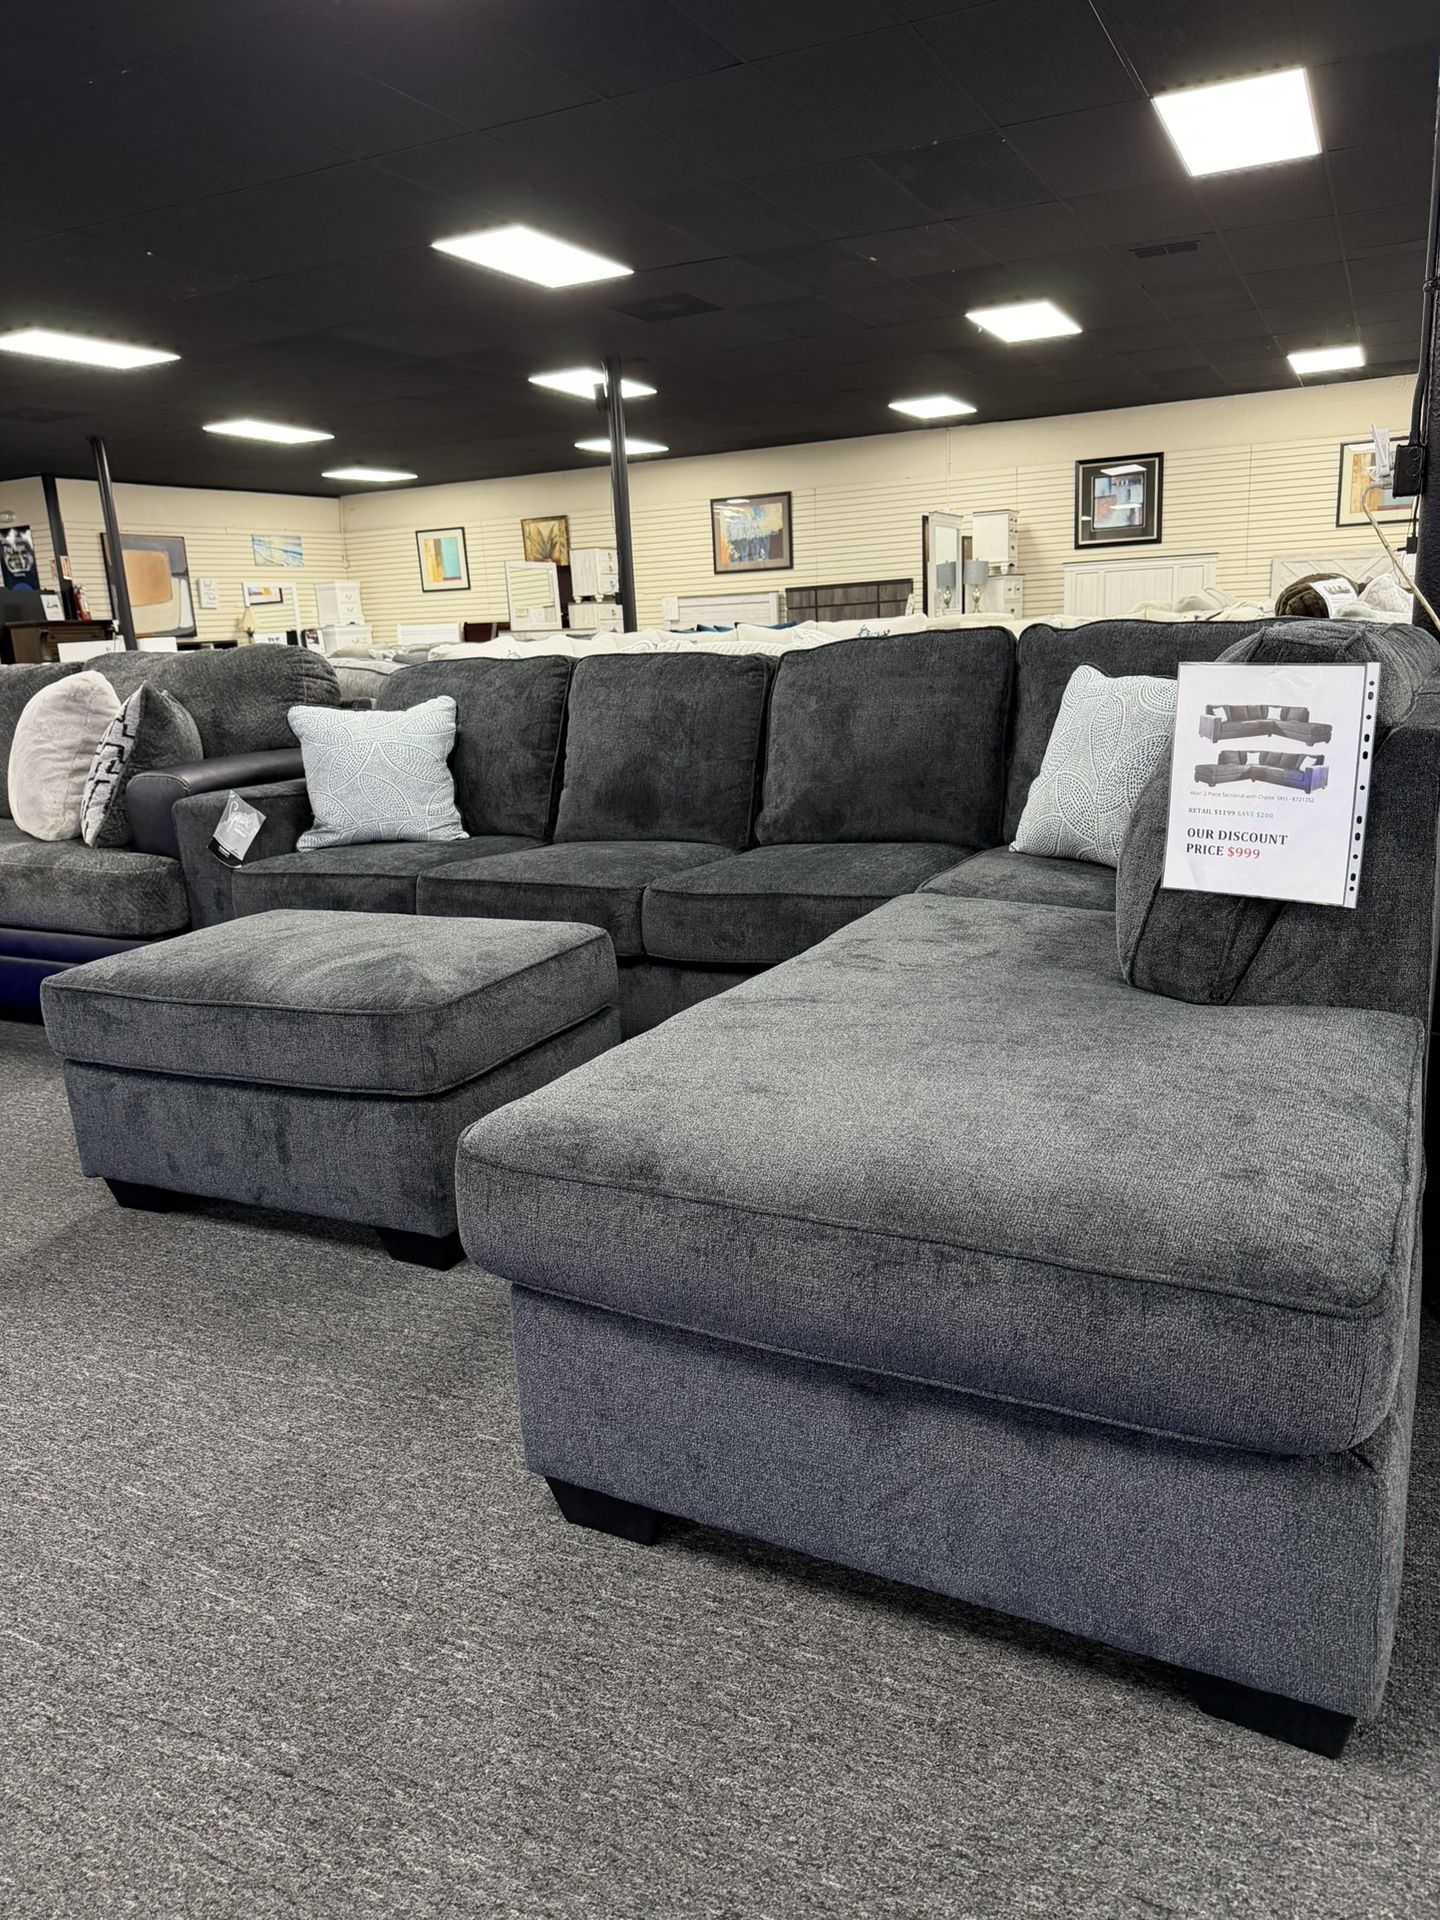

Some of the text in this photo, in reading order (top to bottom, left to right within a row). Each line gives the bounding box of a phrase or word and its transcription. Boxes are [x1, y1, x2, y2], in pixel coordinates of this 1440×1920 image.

[1188, 807, 1274, 819] RETAIL $1199 SAVE $200
[1187, 827, 1288, 845] OUR DISCOUNT
[1186, 843, 1261, 859] PRICE $999
